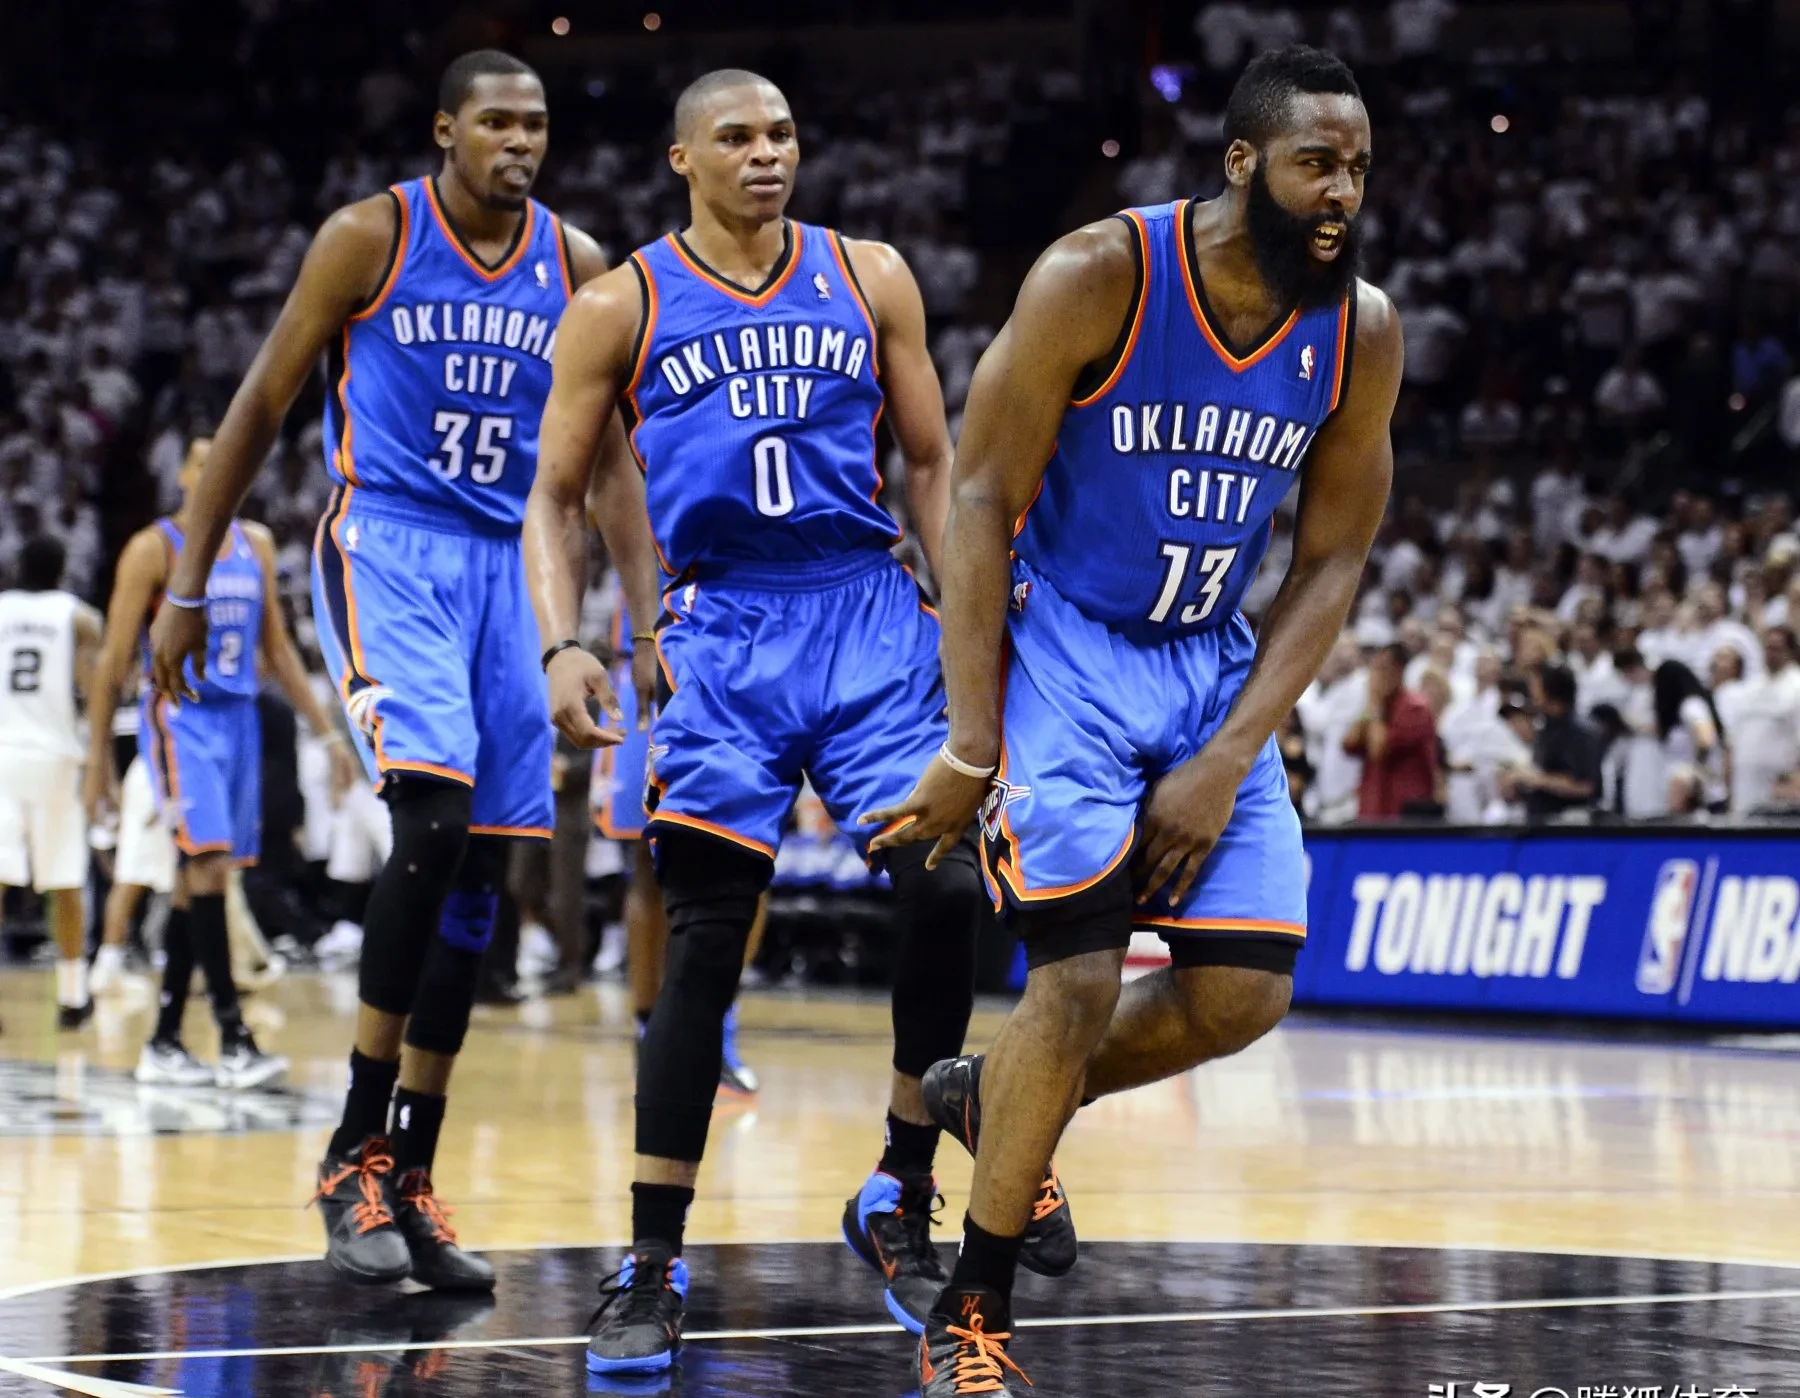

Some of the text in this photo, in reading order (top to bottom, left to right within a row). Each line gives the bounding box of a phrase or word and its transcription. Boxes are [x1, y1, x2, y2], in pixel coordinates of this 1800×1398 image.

[445, 353, 517, 397] CITY
[661, 324, 867, 396] OKLAHOMA
[729, 375, 813, 419] CITY
[428, 411, 513, 485] 35
[754, 436, 794, 517] 0
[1170, 468, 1260, 525] CITY
[1148, 544, 1238, 624] 13
[11, 647, 41, 692] 2
[217, 631, 243, 676] 2
[1346, 871, 1607, 979] TONIGHT
